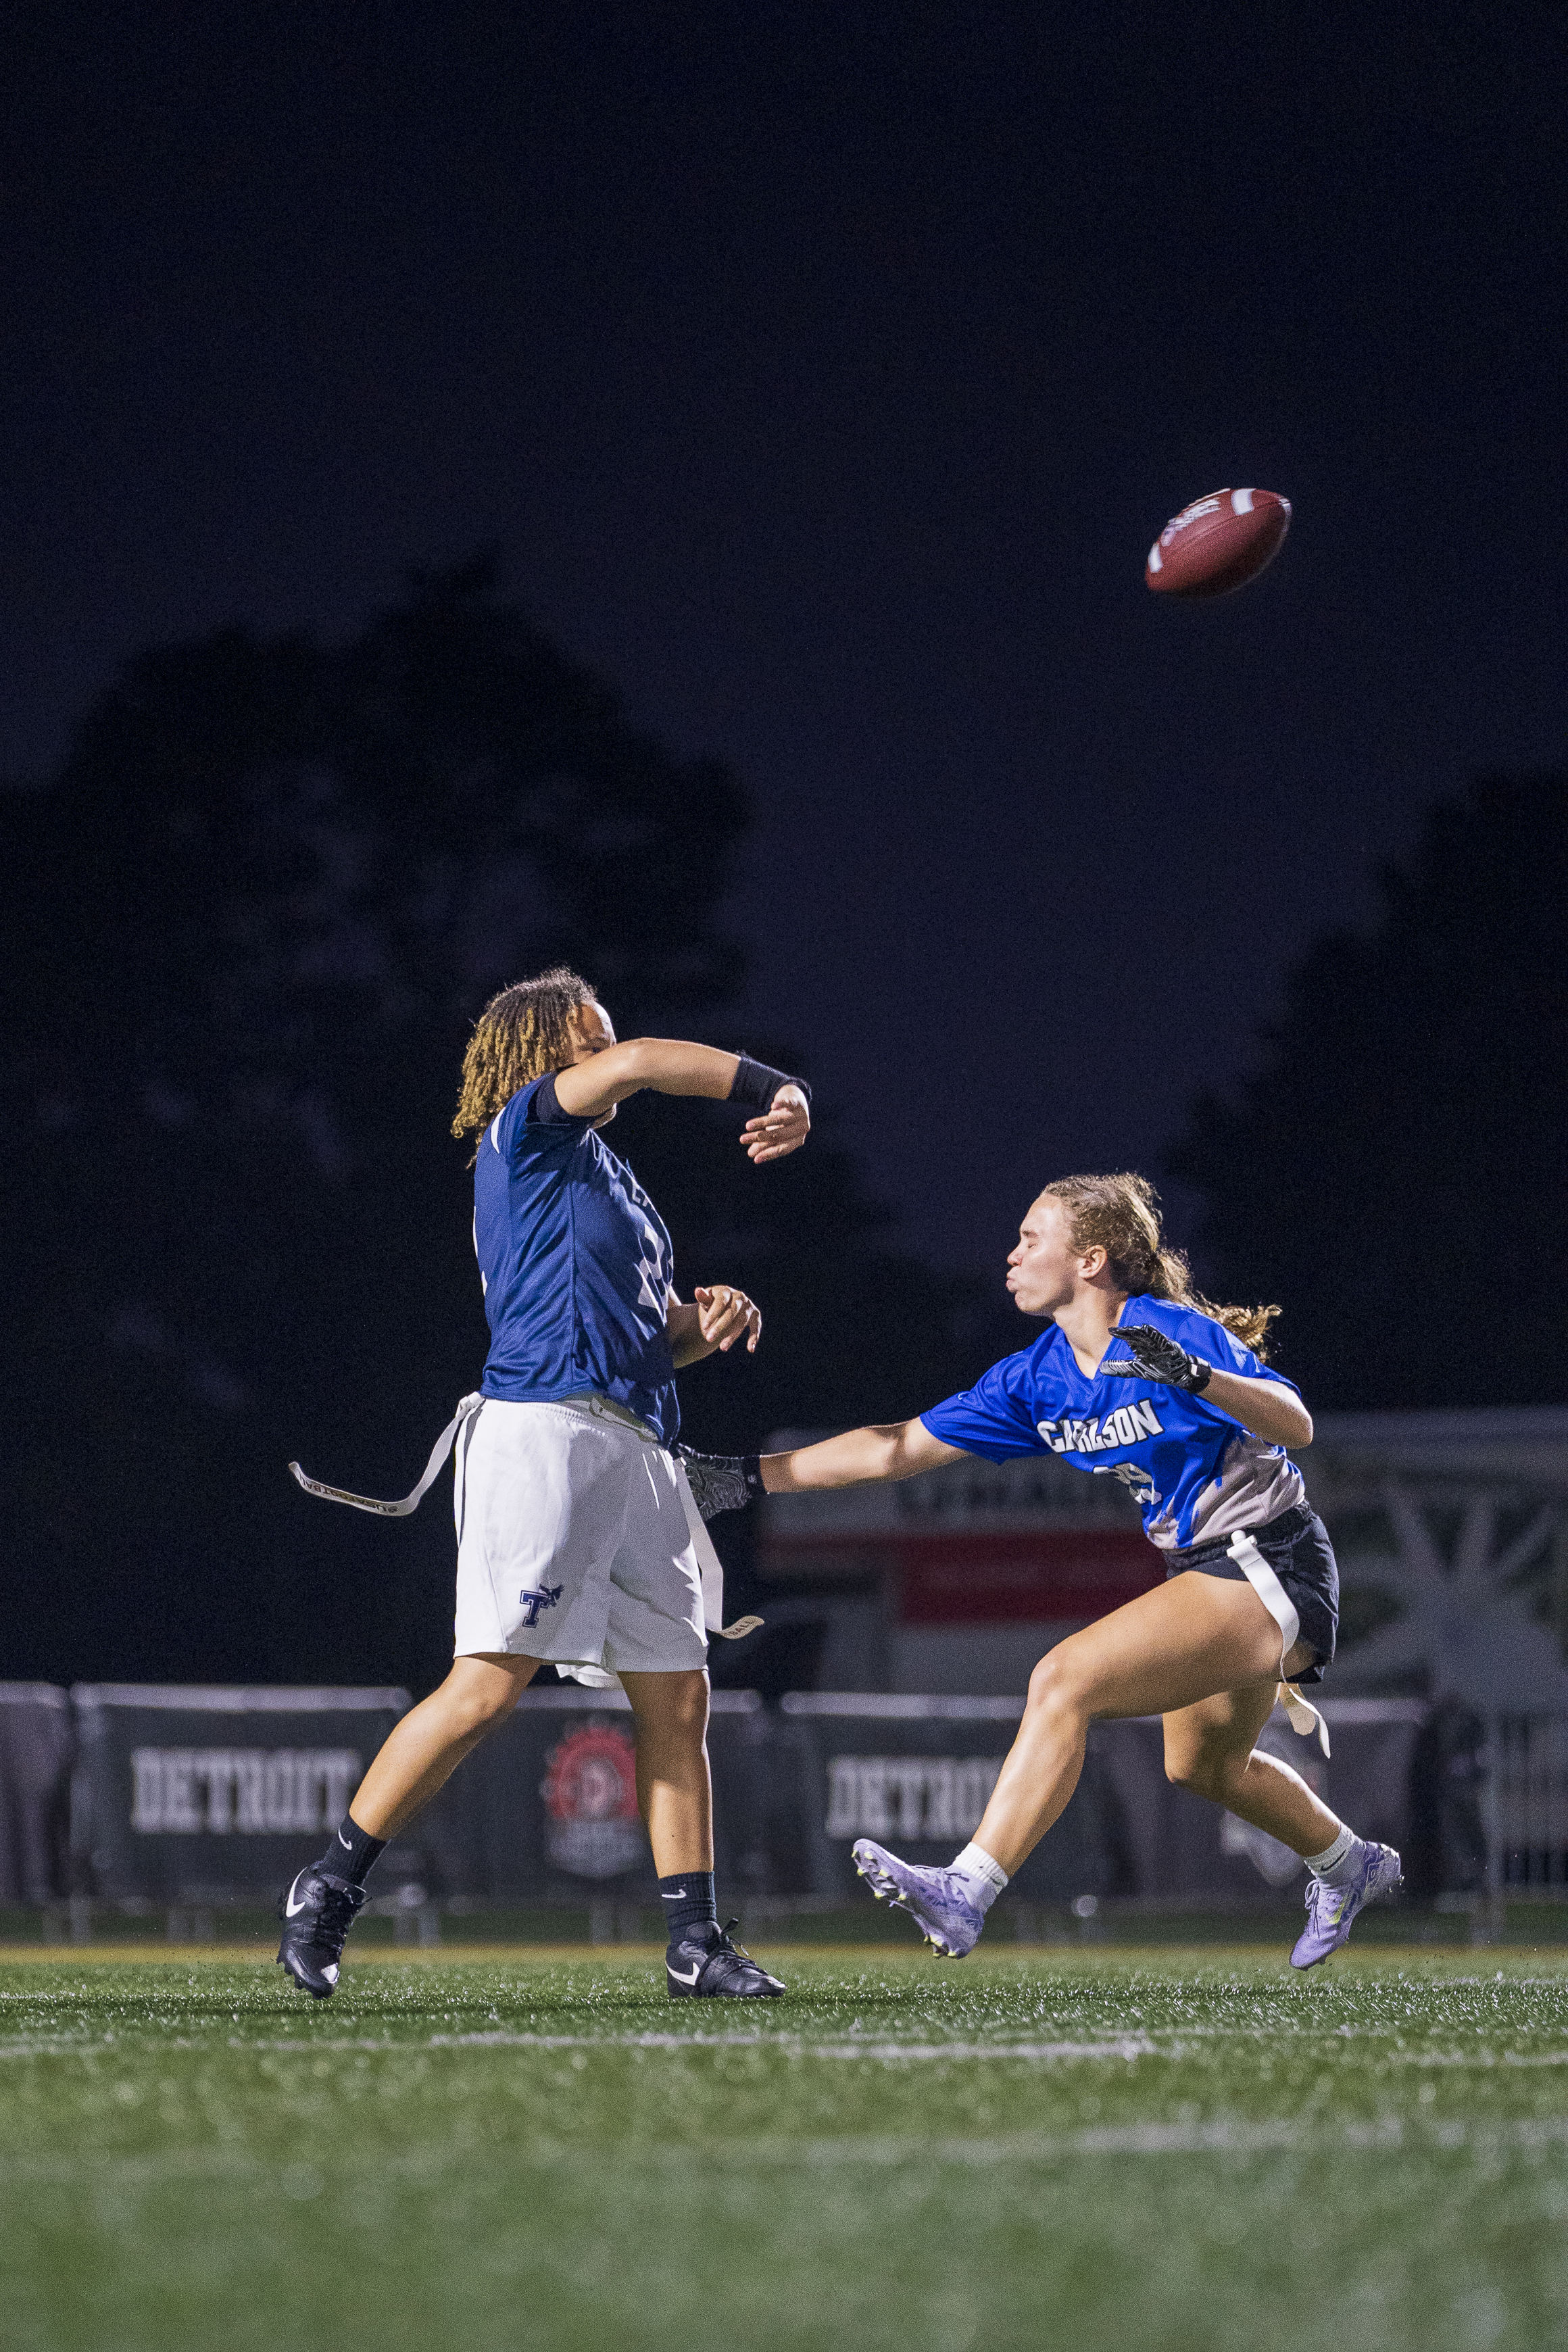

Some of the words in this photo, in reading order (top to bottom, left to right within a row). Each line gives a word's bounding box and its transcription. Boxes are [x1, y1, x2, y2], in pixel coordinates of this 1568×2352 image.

[1036, 1398, 1164, 1454] CARLSON
[132, 1746, 362, 1834] DETROIT
[827, 1757, 1003, 1840] DETRO
